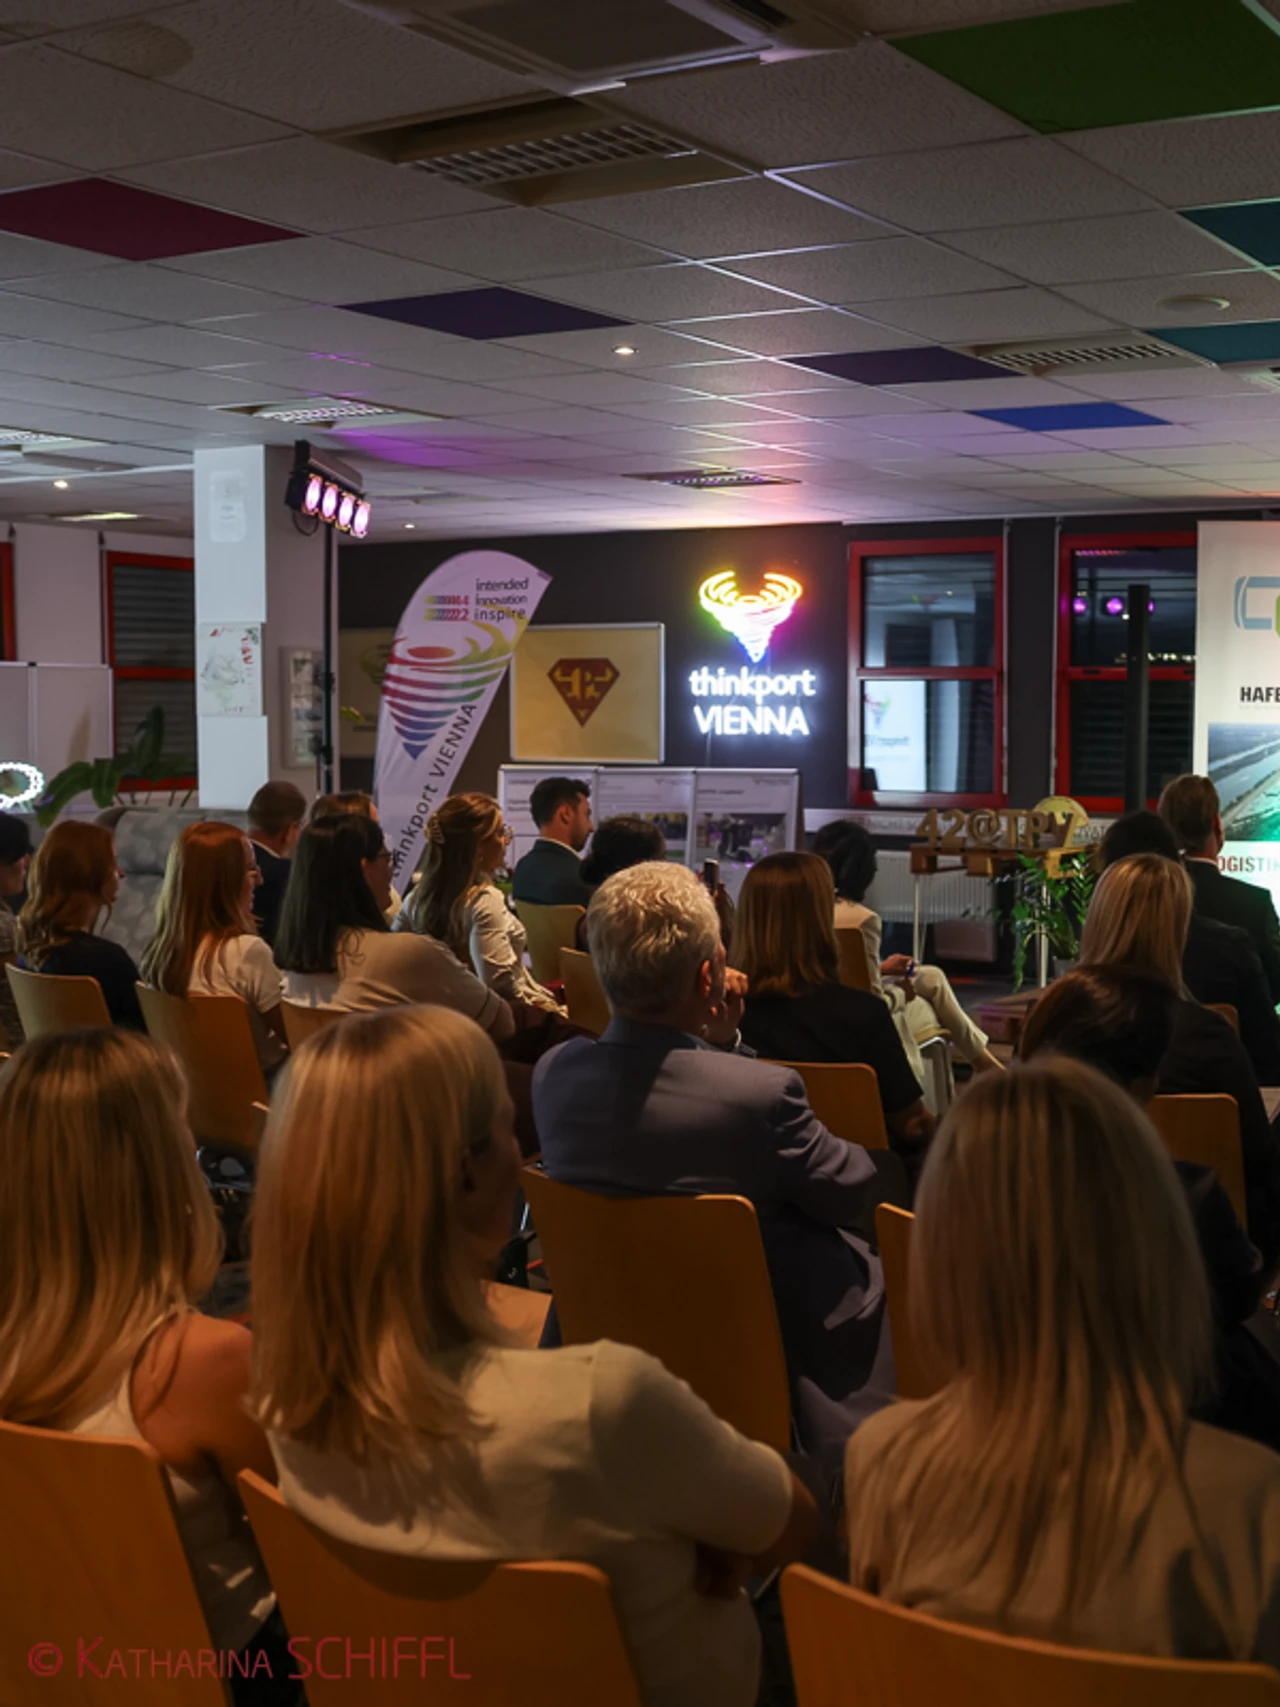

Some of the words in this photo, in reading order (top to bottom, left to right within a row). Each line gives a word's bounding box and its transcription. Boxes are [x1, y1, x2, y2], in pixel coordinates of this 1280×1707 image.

[475, 577, 529, 591] intended
[475, 593, 528, 605] innovation
[474, 606, 526, 622] inspire
[688, 668, 817, 702] thinkport
[693, 705, 810, 736] VIENNA
[429, 704, 477, 779] VIENNA
